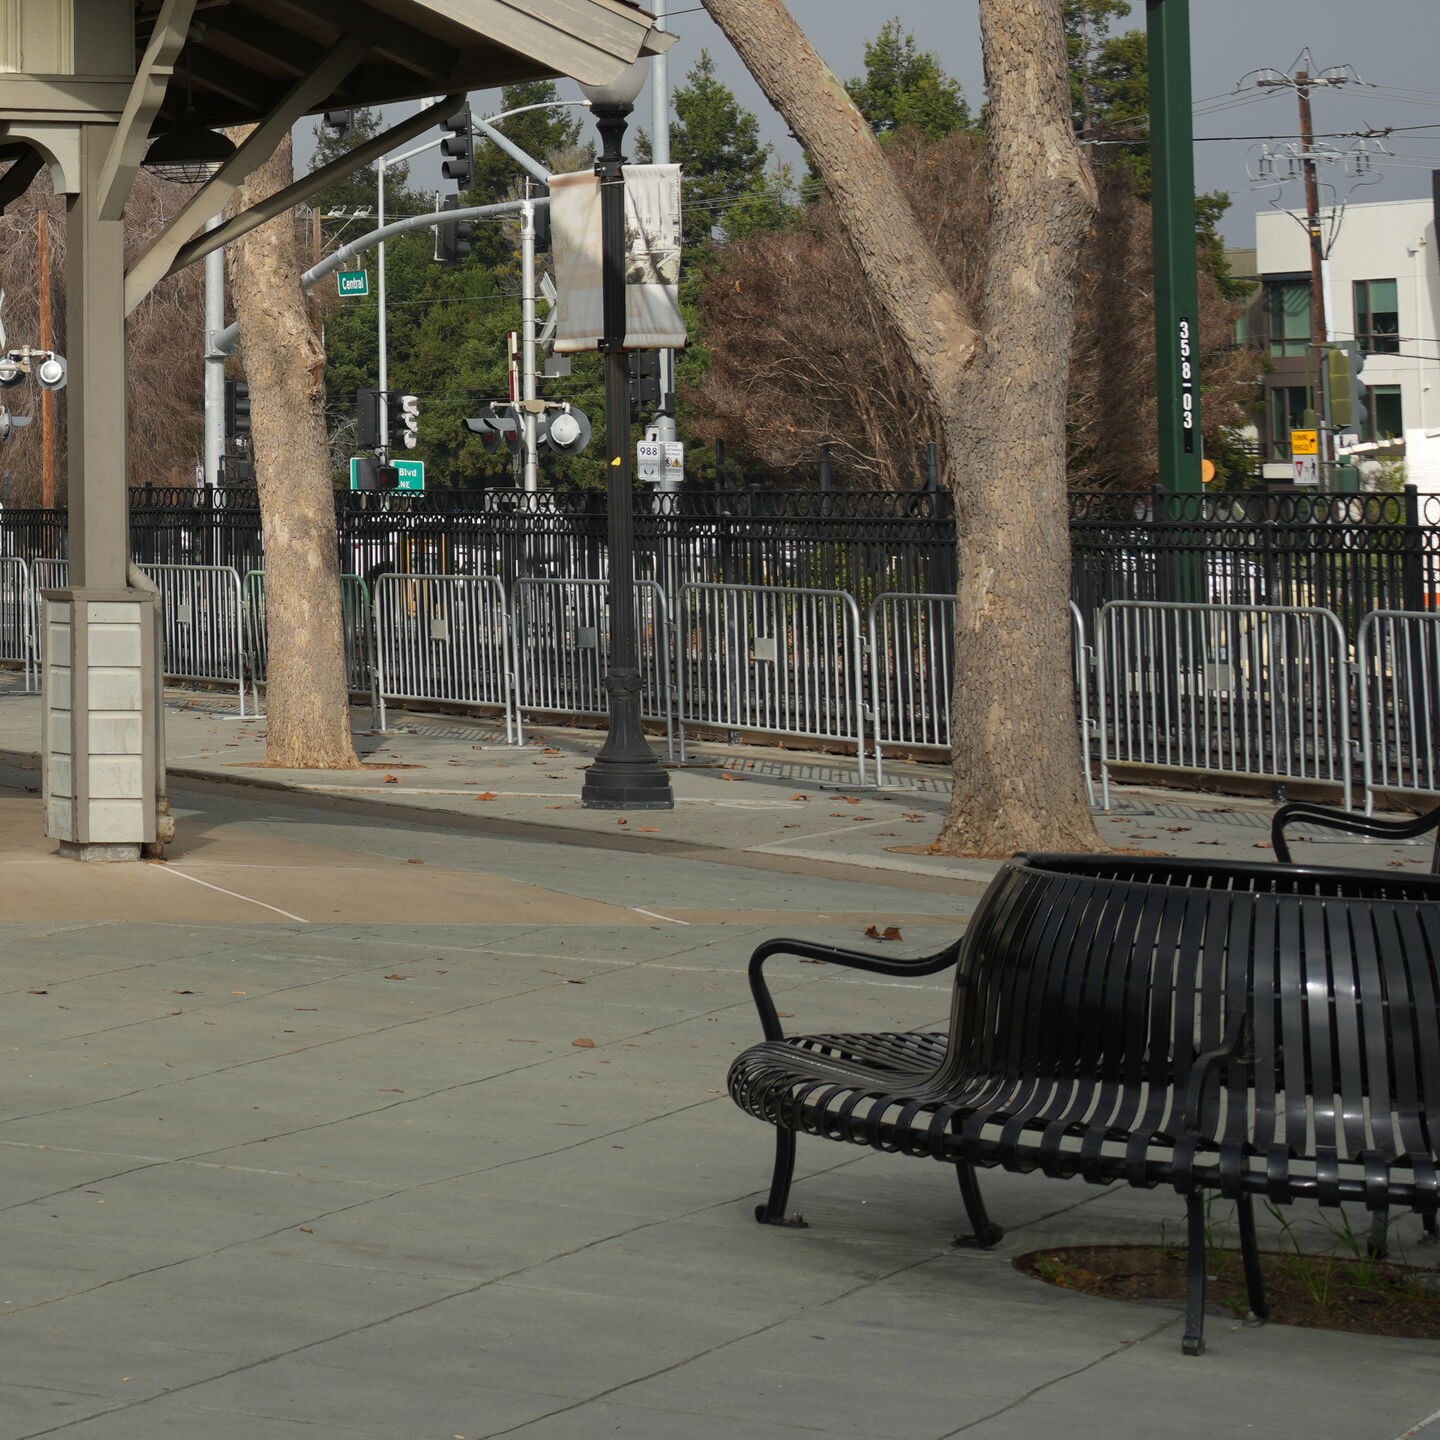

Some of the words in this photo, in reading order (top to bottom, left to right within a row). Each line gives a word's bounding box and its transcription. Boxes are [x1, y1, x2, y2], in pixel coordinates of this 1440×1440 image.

[341, 276, 364, 291] Central
[640, 447, 658, 456] 988
[399, 467, 417, 477] Blvd
